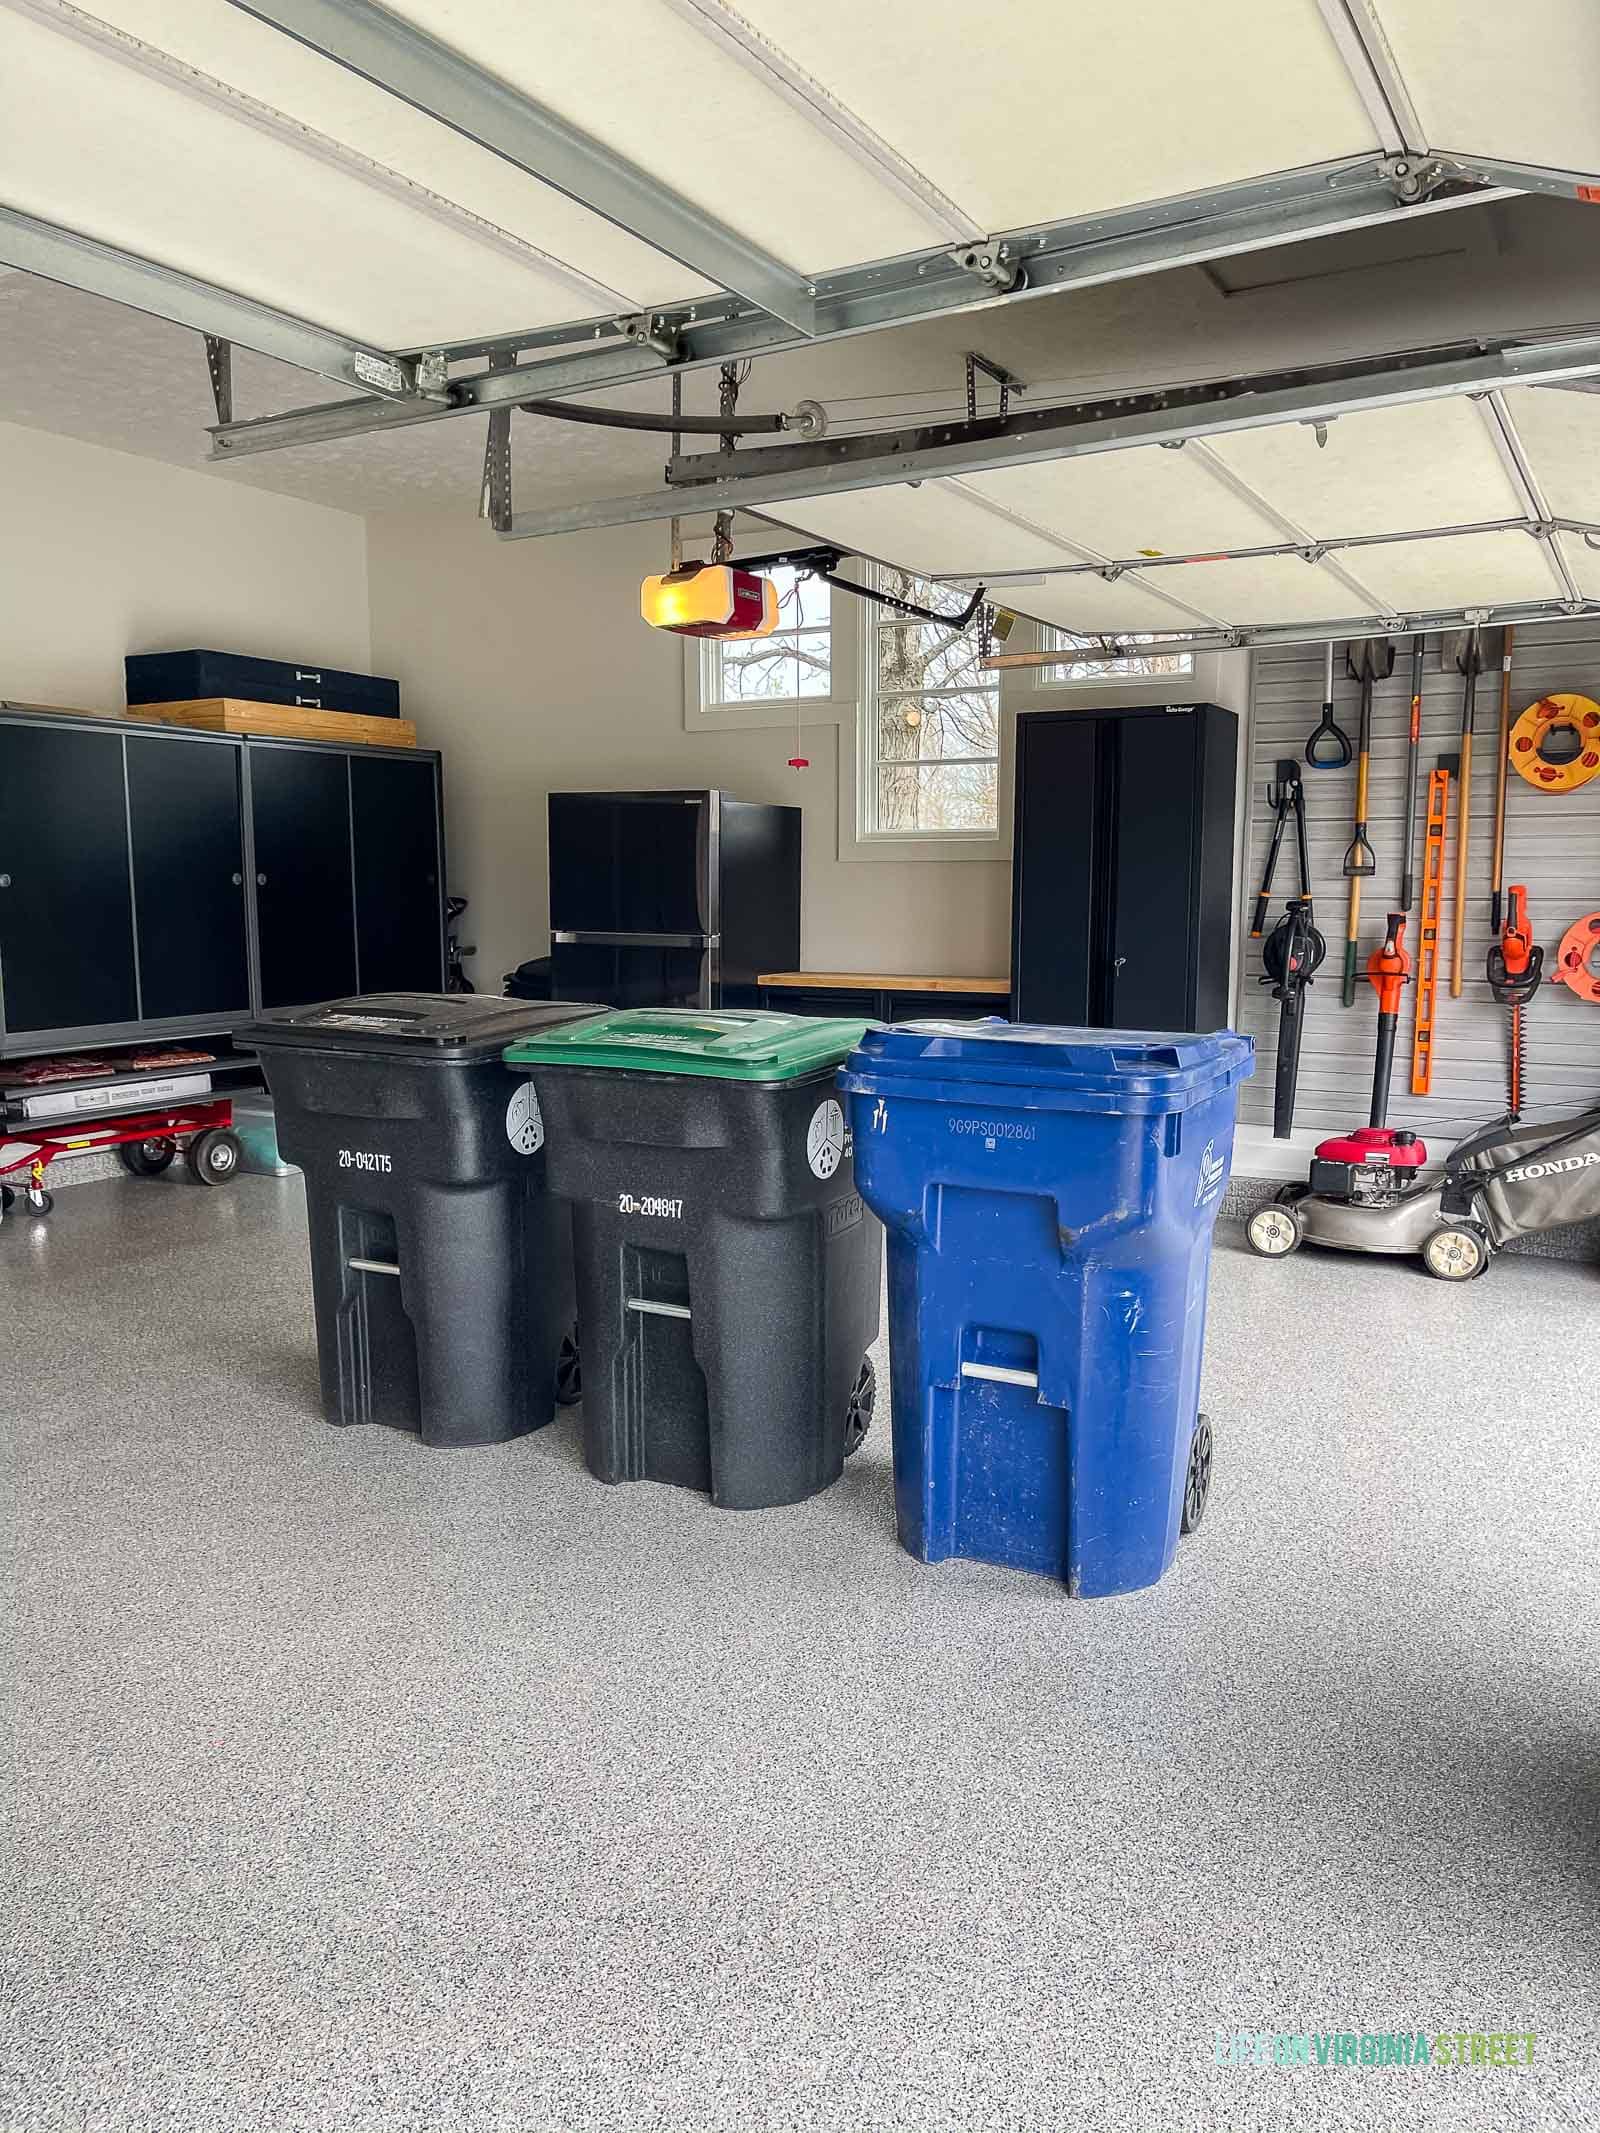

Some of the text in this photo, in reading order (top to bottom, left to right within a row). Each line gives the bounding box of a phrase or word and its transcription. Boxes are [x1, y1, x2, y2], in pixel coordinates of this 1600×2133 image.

[339, 1149, 392, 1172] 20-042175
[1505, 1152, 1600, 1183] HONDA
[619, 1193, 683, 1219] 20-204847
